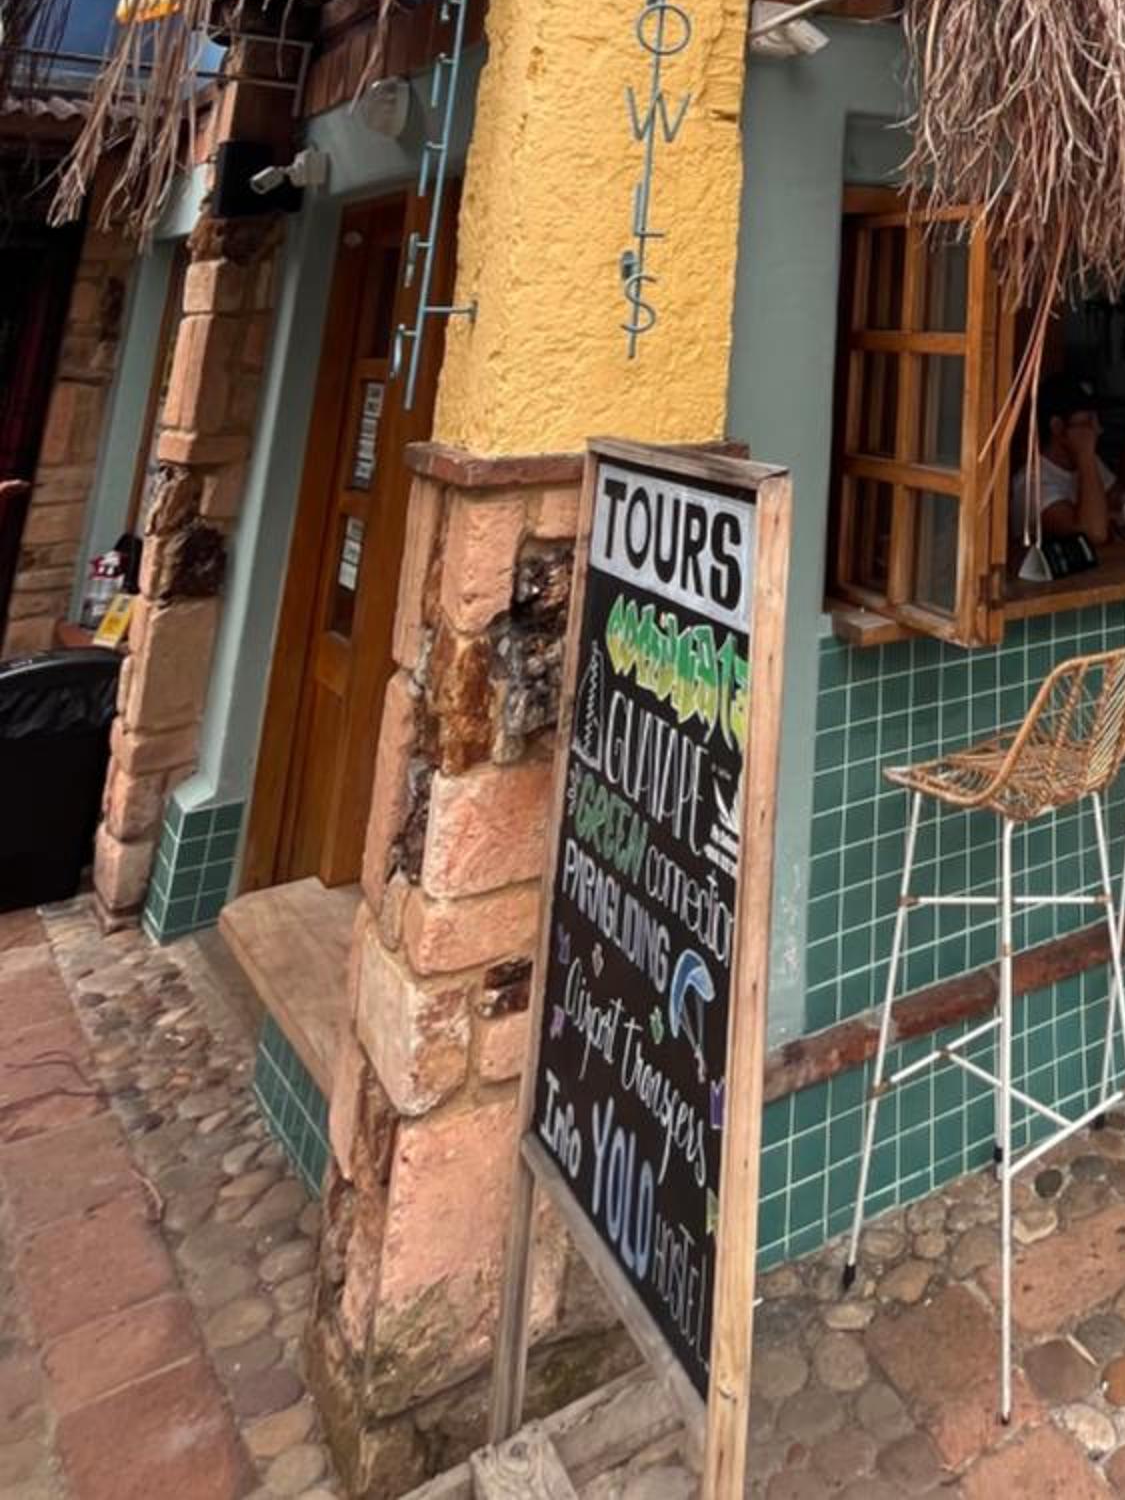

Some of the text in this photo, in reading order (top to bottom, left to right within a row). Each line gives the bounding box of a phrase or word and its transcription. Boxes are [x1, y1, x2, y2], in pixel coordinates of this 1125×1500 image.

[604, 479, 742, 612] TOURS
[575, 772, 649, 885] GREEN
[561, 837, 671, 993] PARAGLIDING
[540, 1068, 583, 1178] Info
[591, 1096, 654, 1278] YOLO
